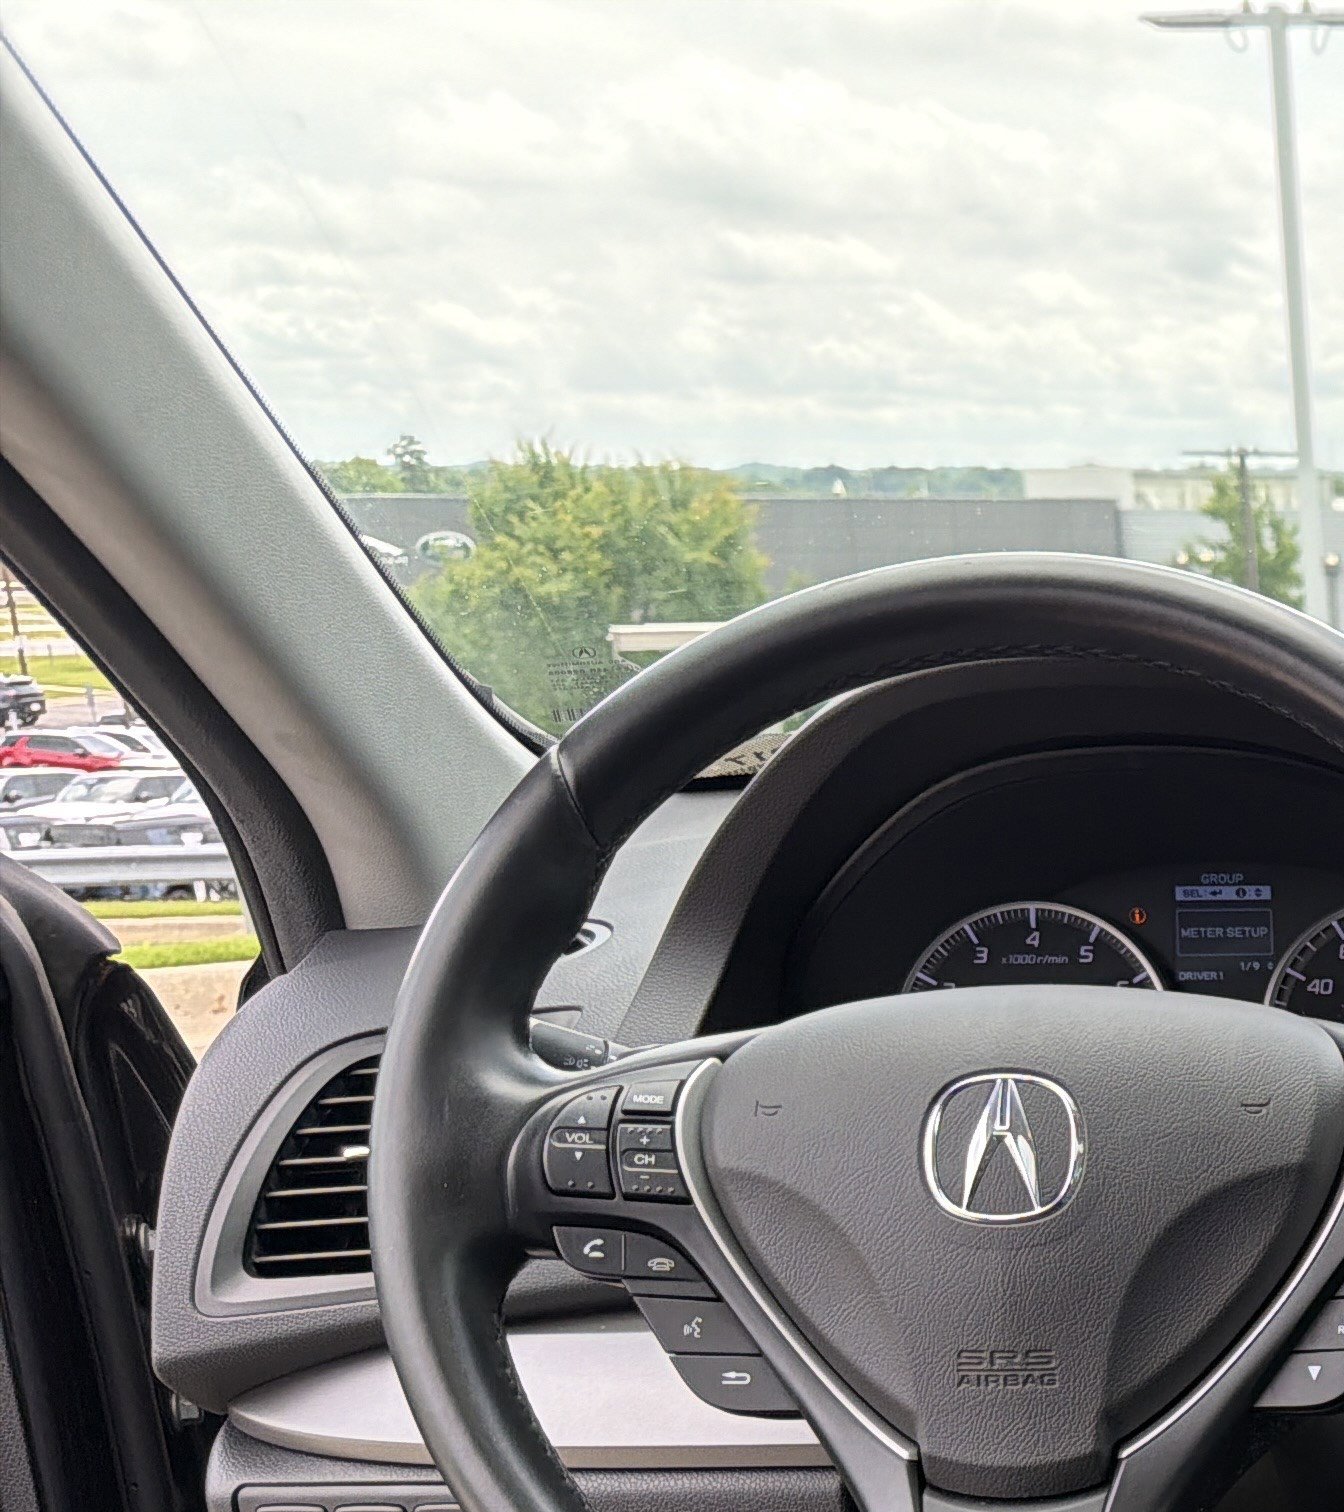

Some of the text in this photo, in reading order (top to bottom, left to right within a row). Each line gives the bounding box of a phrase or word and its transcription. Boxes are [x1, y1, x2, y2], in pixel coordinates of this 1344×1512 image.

[1201, 873, 1244, 884] GROUP
[1180, 926, 1269, 938] METER SETUP
[1025, 931, 1040, 948] 4
[973, 946, 989, 964] 3
[1079, 946, 1093, 963] 5
[1240, 961, 1260, 971] 1/9
[1178, 971, 1217, 981] DRIVER
[1306, 978, 1334, 995] 40
[632, 1093, 665, 1105] MODE
[565, 1132, 595, 1145] VOL
[633, 1153, 656, 1165] CH
[956, 1348, 1058, 1369] SRS
[956, 1373, 1058, 1388] AIRBAG
